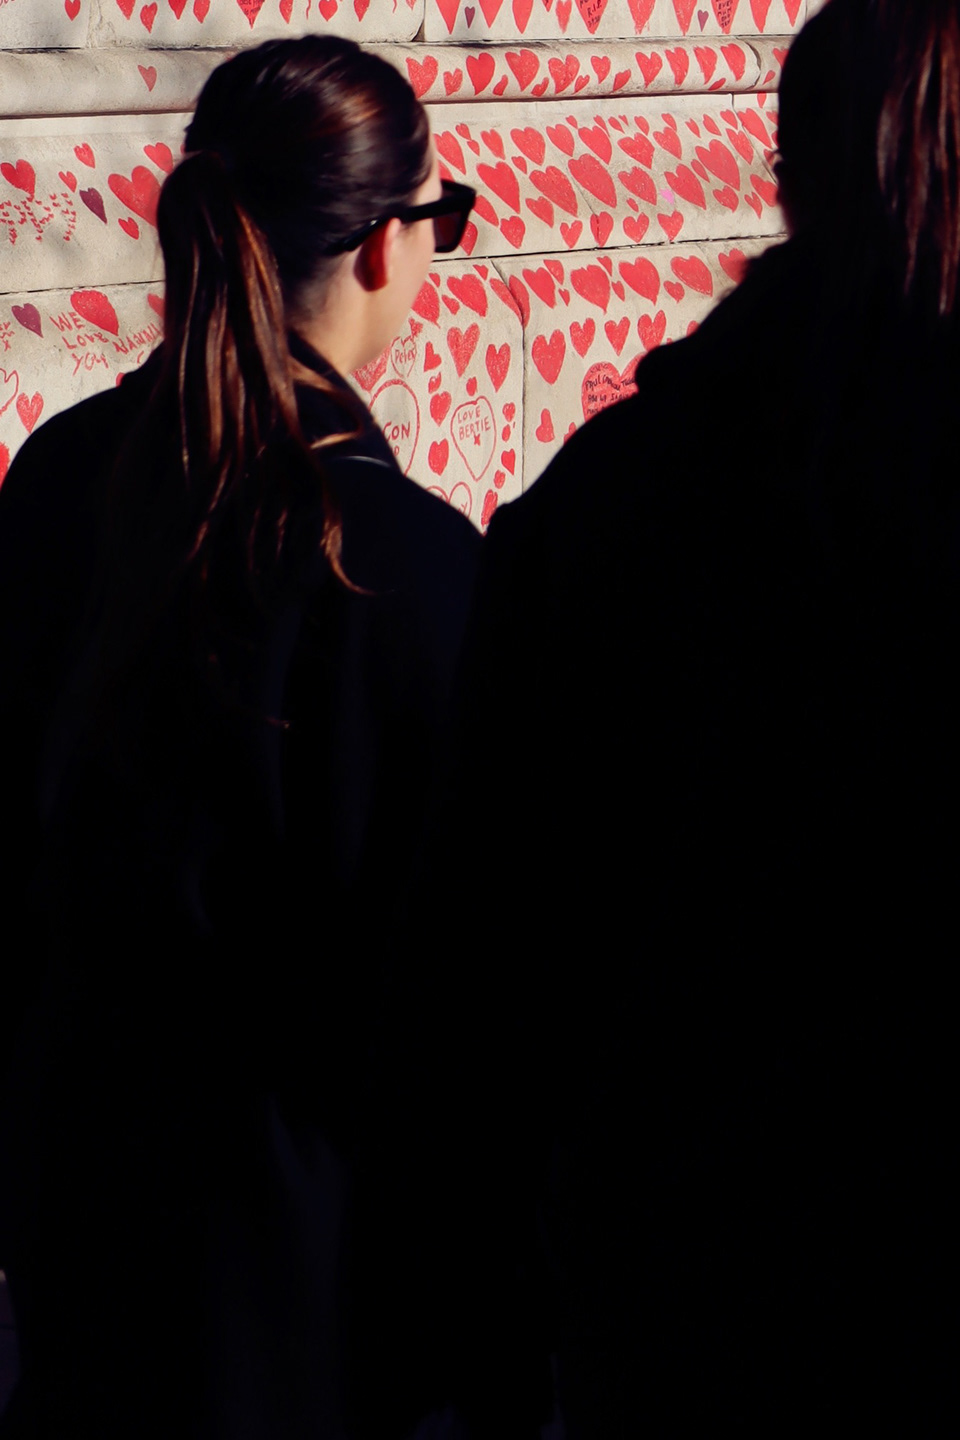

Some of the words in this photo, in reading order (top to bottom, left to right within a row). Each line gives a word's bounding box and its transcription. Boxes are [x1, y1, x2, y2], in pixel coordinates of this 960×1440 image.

[50, 311, 86, 332] WE
[457, 406, 481, 424] LOVE
[459, 418, 491, 441] BERTIE
